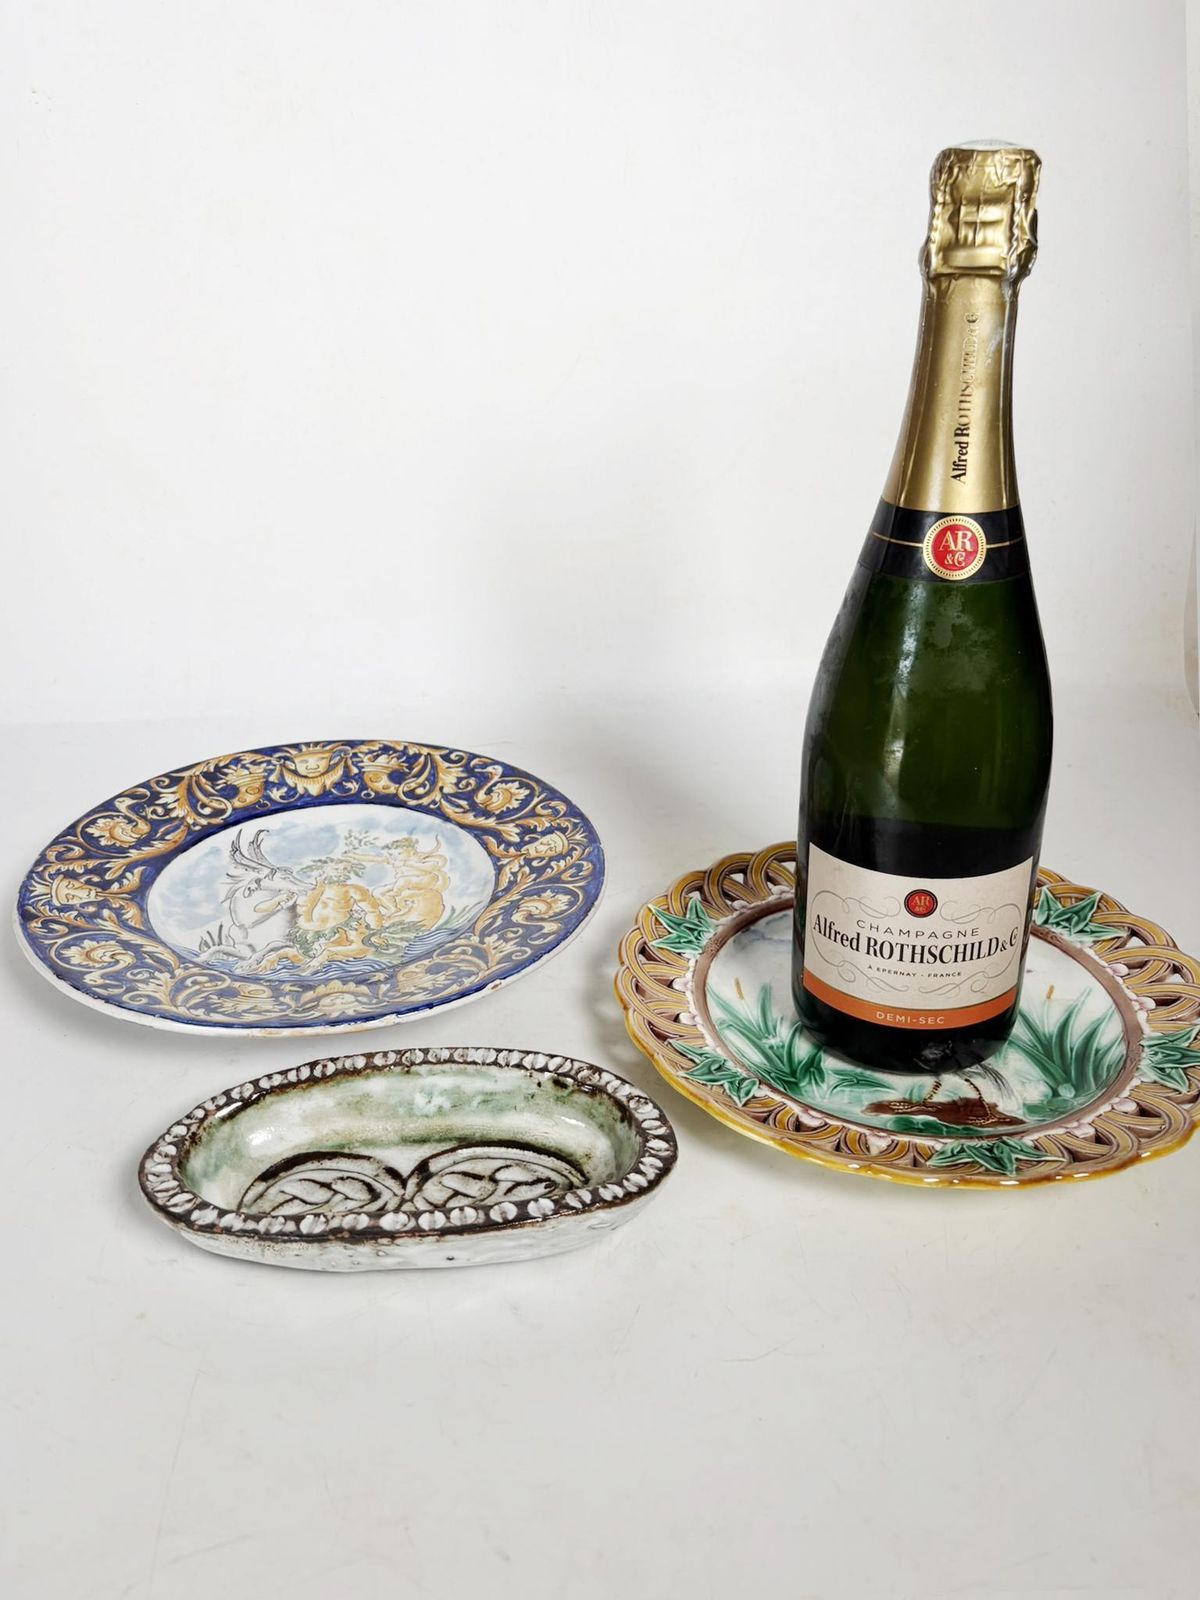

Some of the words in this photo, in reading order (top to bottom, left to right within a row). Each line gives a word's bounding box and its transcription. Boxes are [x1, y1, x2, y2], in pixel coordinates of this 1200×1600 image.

[950, 441, 970, 484] Alfred
[938, 530, 974, 552] AR
[813, 914, 860, 952] Alfred
[856, 919, 980, 939] CHAMPAGNE
[876, 967, 917, 978] EPERNAY
[876, 1011, 945, 1025] DEMI-SEC
